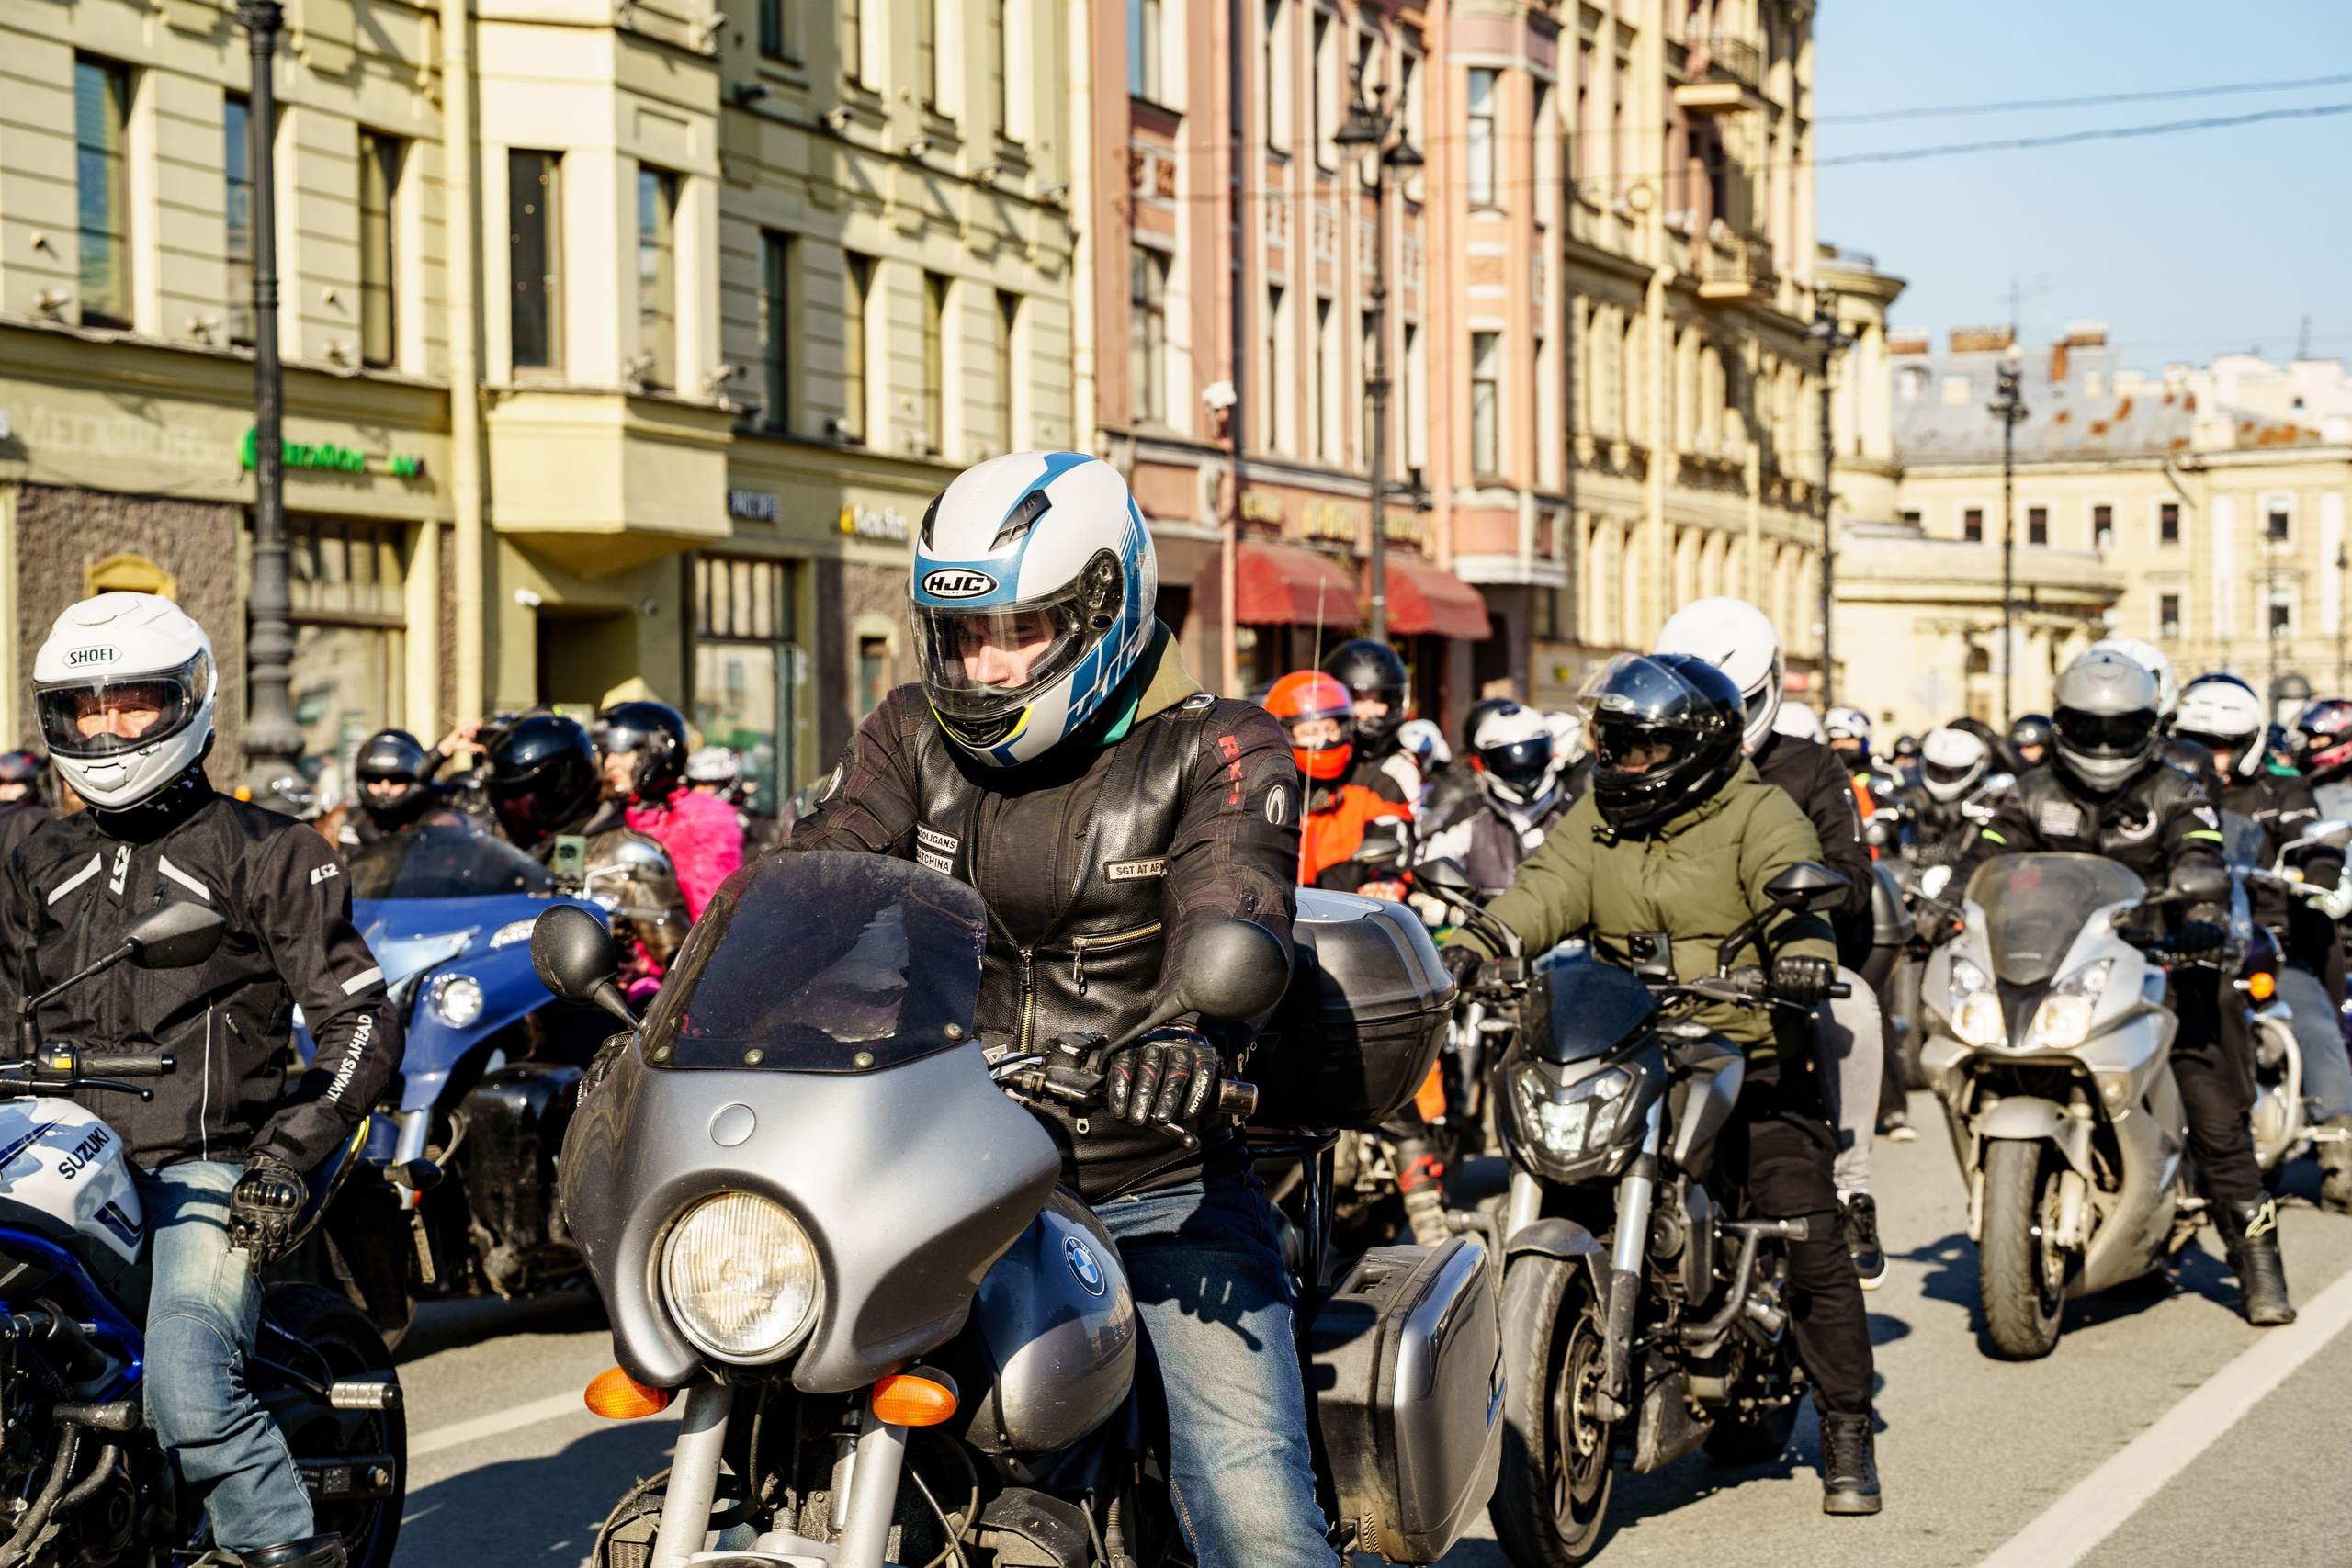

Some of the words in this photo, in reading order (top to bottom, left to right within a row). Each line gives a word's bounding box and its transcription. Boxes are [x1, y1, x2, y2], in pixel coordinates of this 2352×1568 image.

[928, 576, 985, 591] HJC
[70, 649, 112, 665] SHOEI
[109, 845, 132, 895] LS2
[311, 863, 340, 885] LS2
[1116, 865, 1135, 876] SGT
[1137, 864, 1148, 874] AT
[347, 1014, 373, 1061] AHEAD
[58, 1126, 111, 1180] SUZUKI
[1068, 1239, 1090, 1262] BMW
